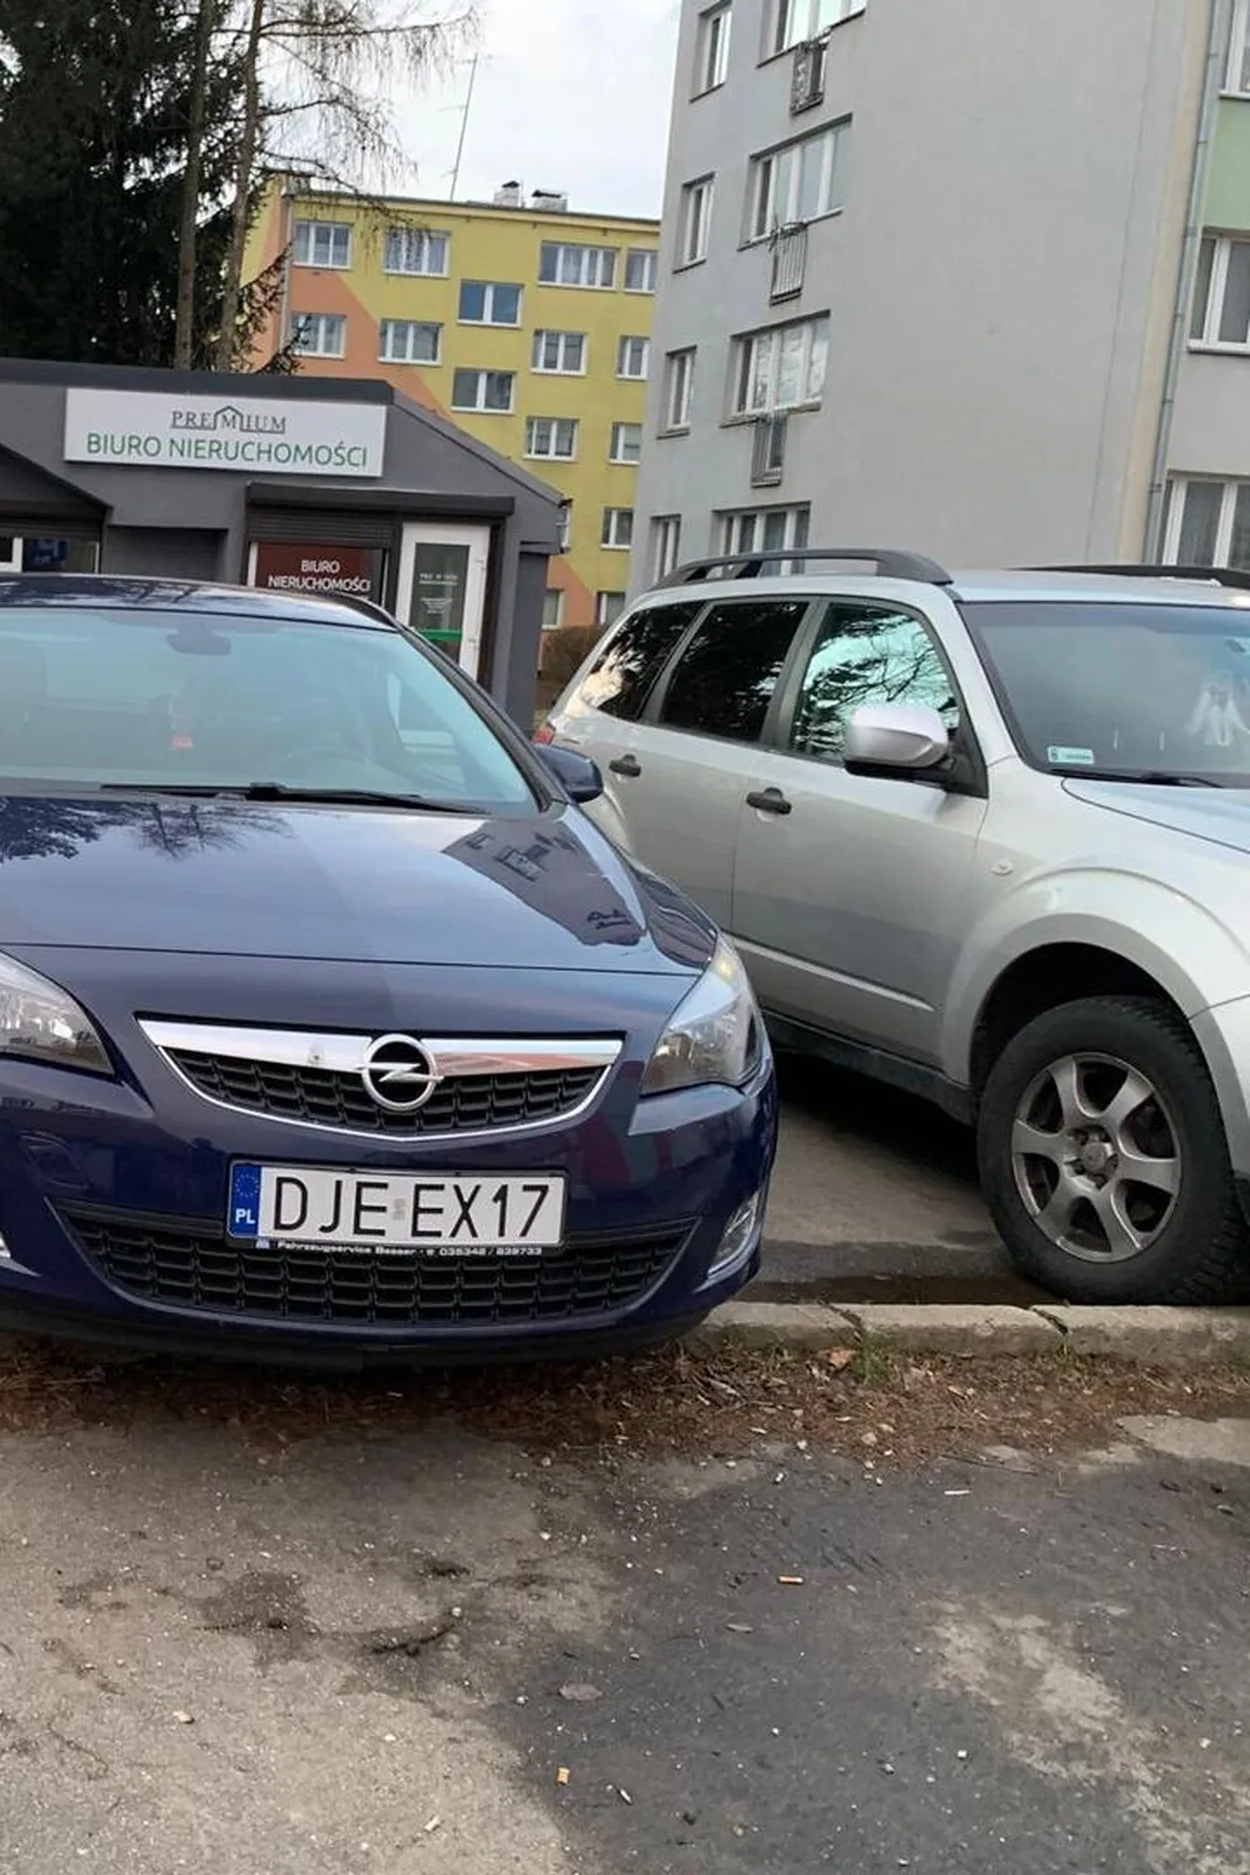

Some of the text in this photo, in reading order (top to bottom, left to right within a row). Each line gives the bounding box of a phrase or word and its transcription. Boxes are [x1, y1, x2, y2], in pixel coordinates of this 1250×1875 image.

[171, 409, 286, 434] PREMIUM
[86, 432, 367, 468] BIURO NIERUCHOMOŚCI
[301, 559, 341, 574] BIURO
[235, 1208, 255, 1225] PL
[273, 1176, 550, 1239] DJE EX17
